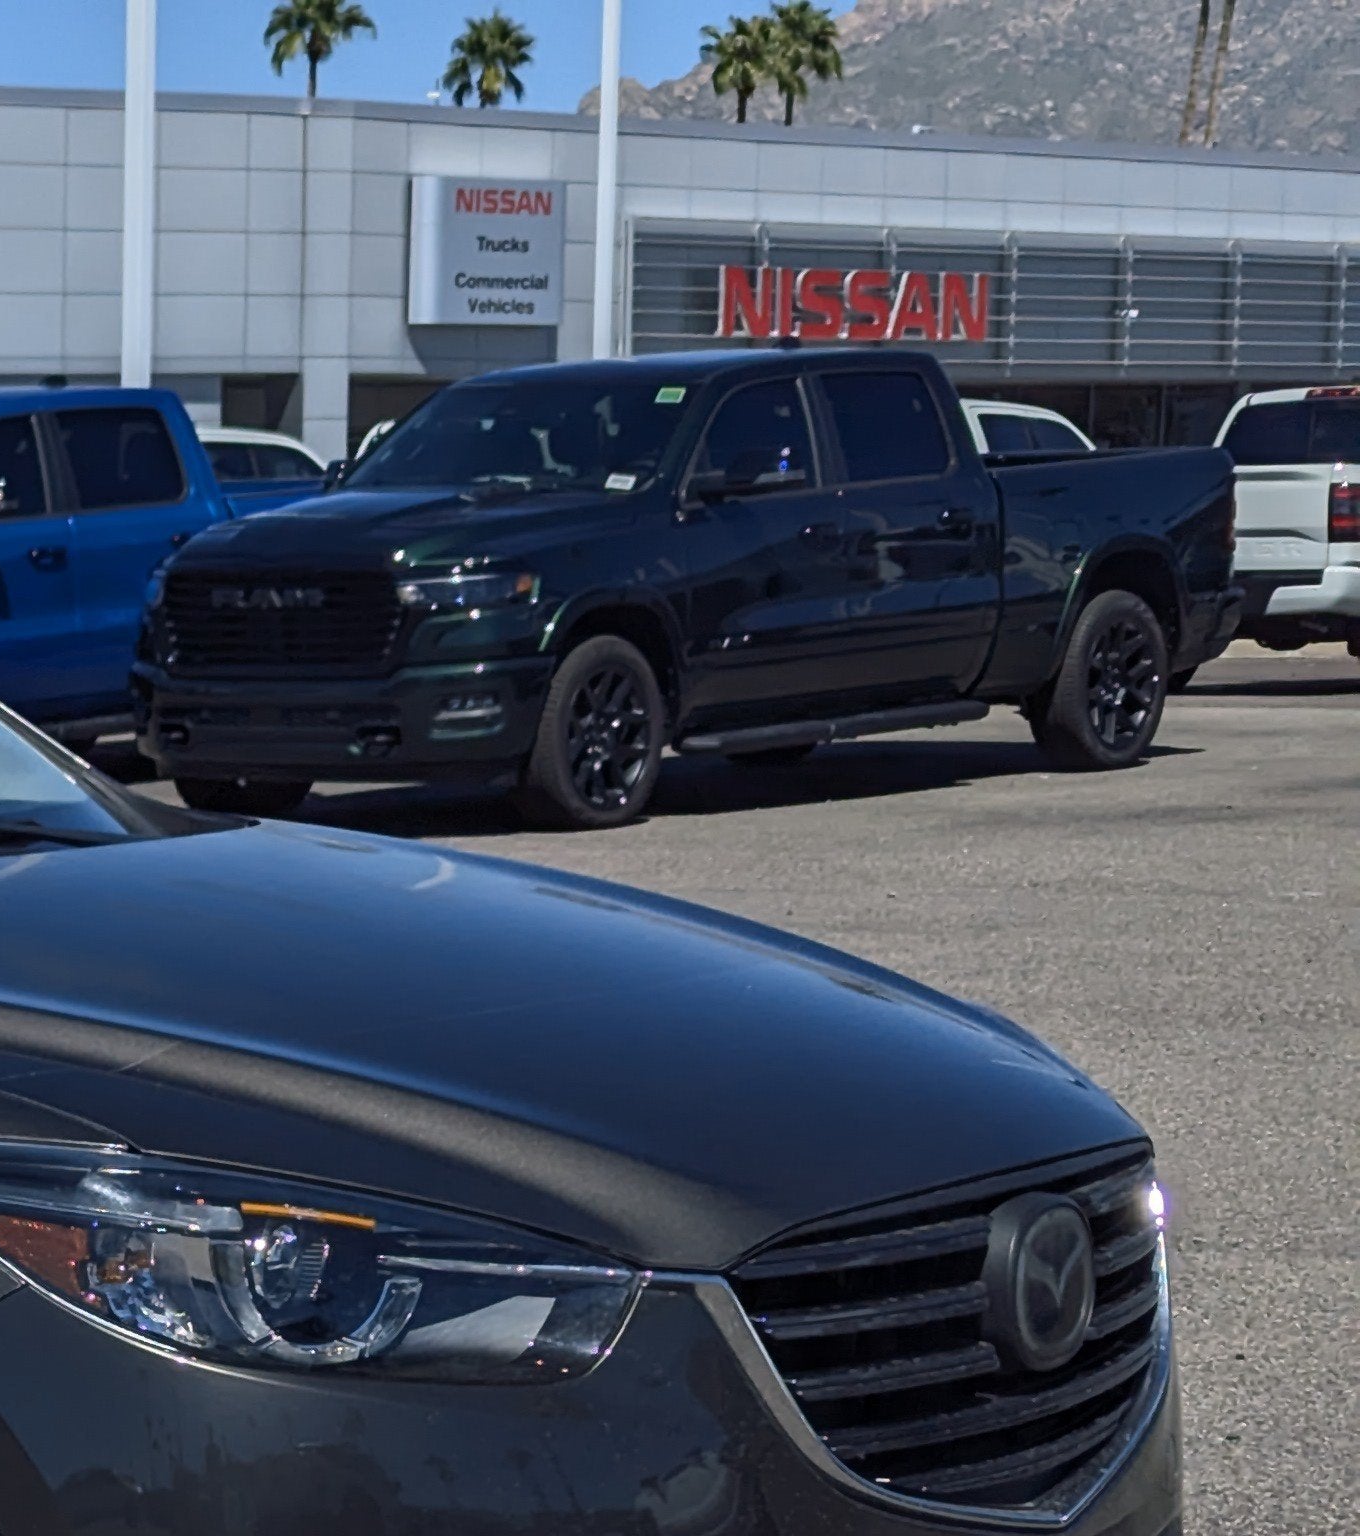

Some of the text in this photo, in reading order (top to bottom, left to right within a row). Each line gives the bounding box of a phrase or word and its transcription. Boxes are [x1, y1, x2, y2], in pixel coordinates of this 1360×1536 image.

[455, 187, 553, 217] NISSAN
[476, 234, 530, 255] Trucks
[454, 272, 549, 292] Commercial
[467, 296, 535, 317] Vehicles
[717, 264, 991, 342] NISSAN
[211, 586, 325, 609] RAM
